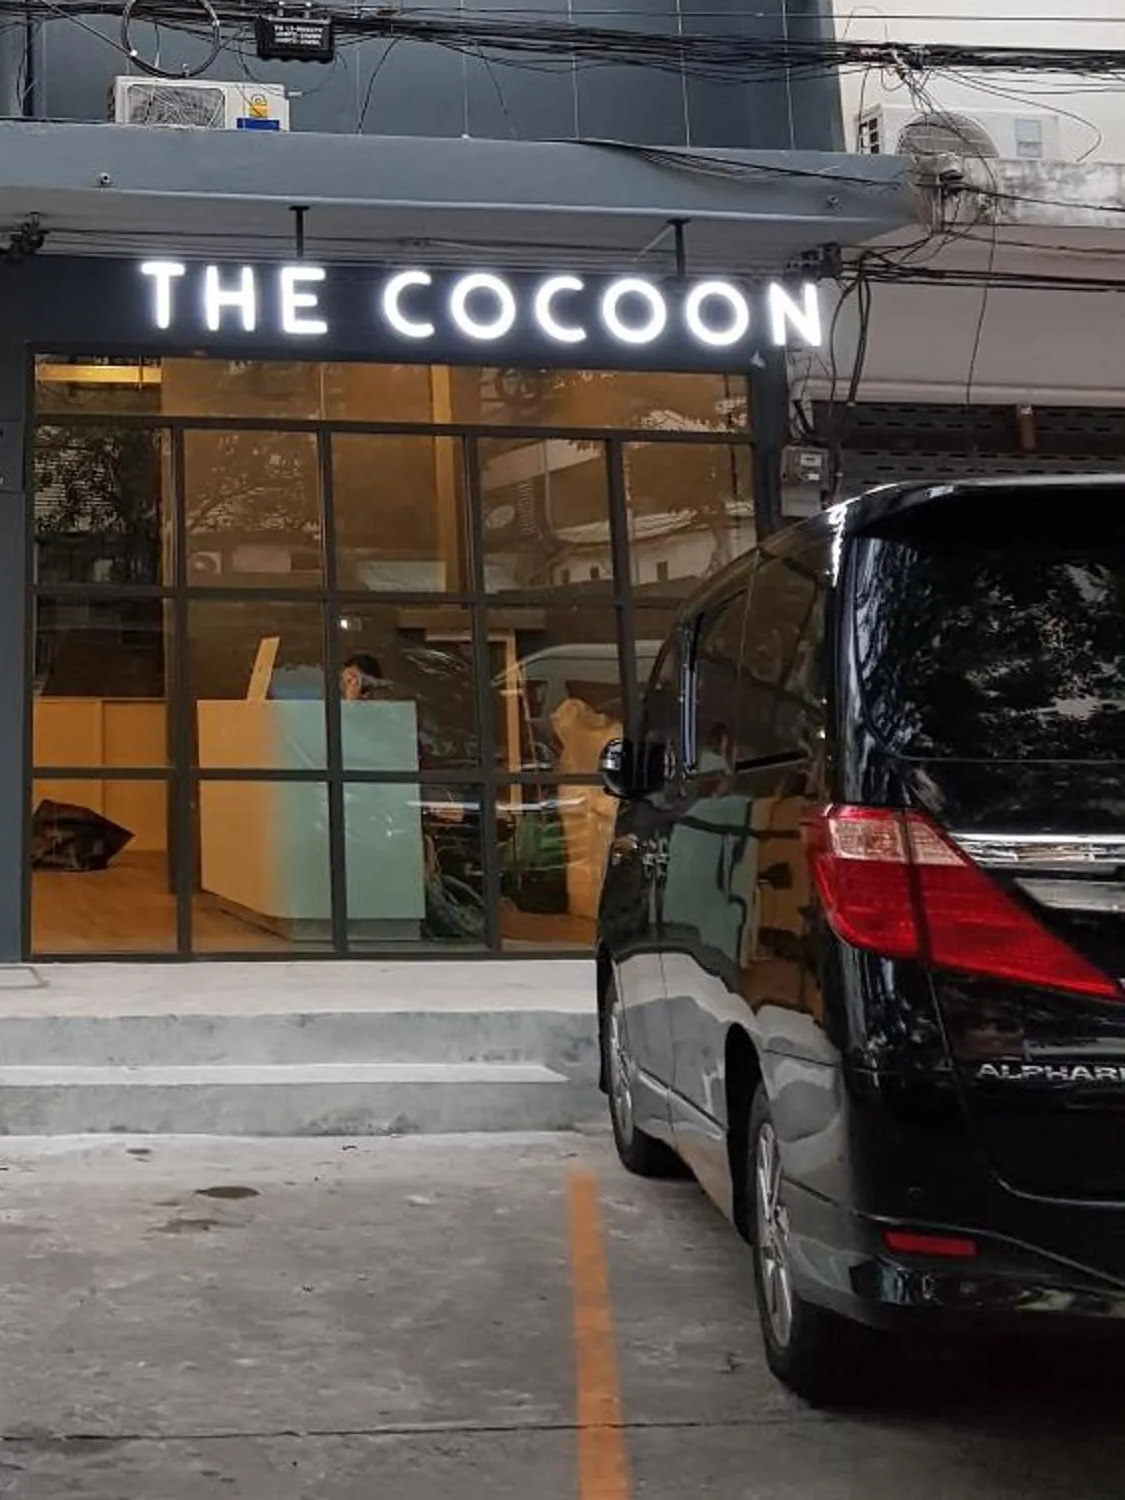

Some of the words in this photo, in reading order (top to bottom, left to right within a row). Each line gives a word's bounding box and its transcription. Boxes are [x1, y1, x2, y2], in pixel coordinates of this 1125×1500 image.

[140, 261, 328, 334] THE
[383, 271, 821, 346] COCOON
[976, 1063, 1125, 1081] ALPHAR
